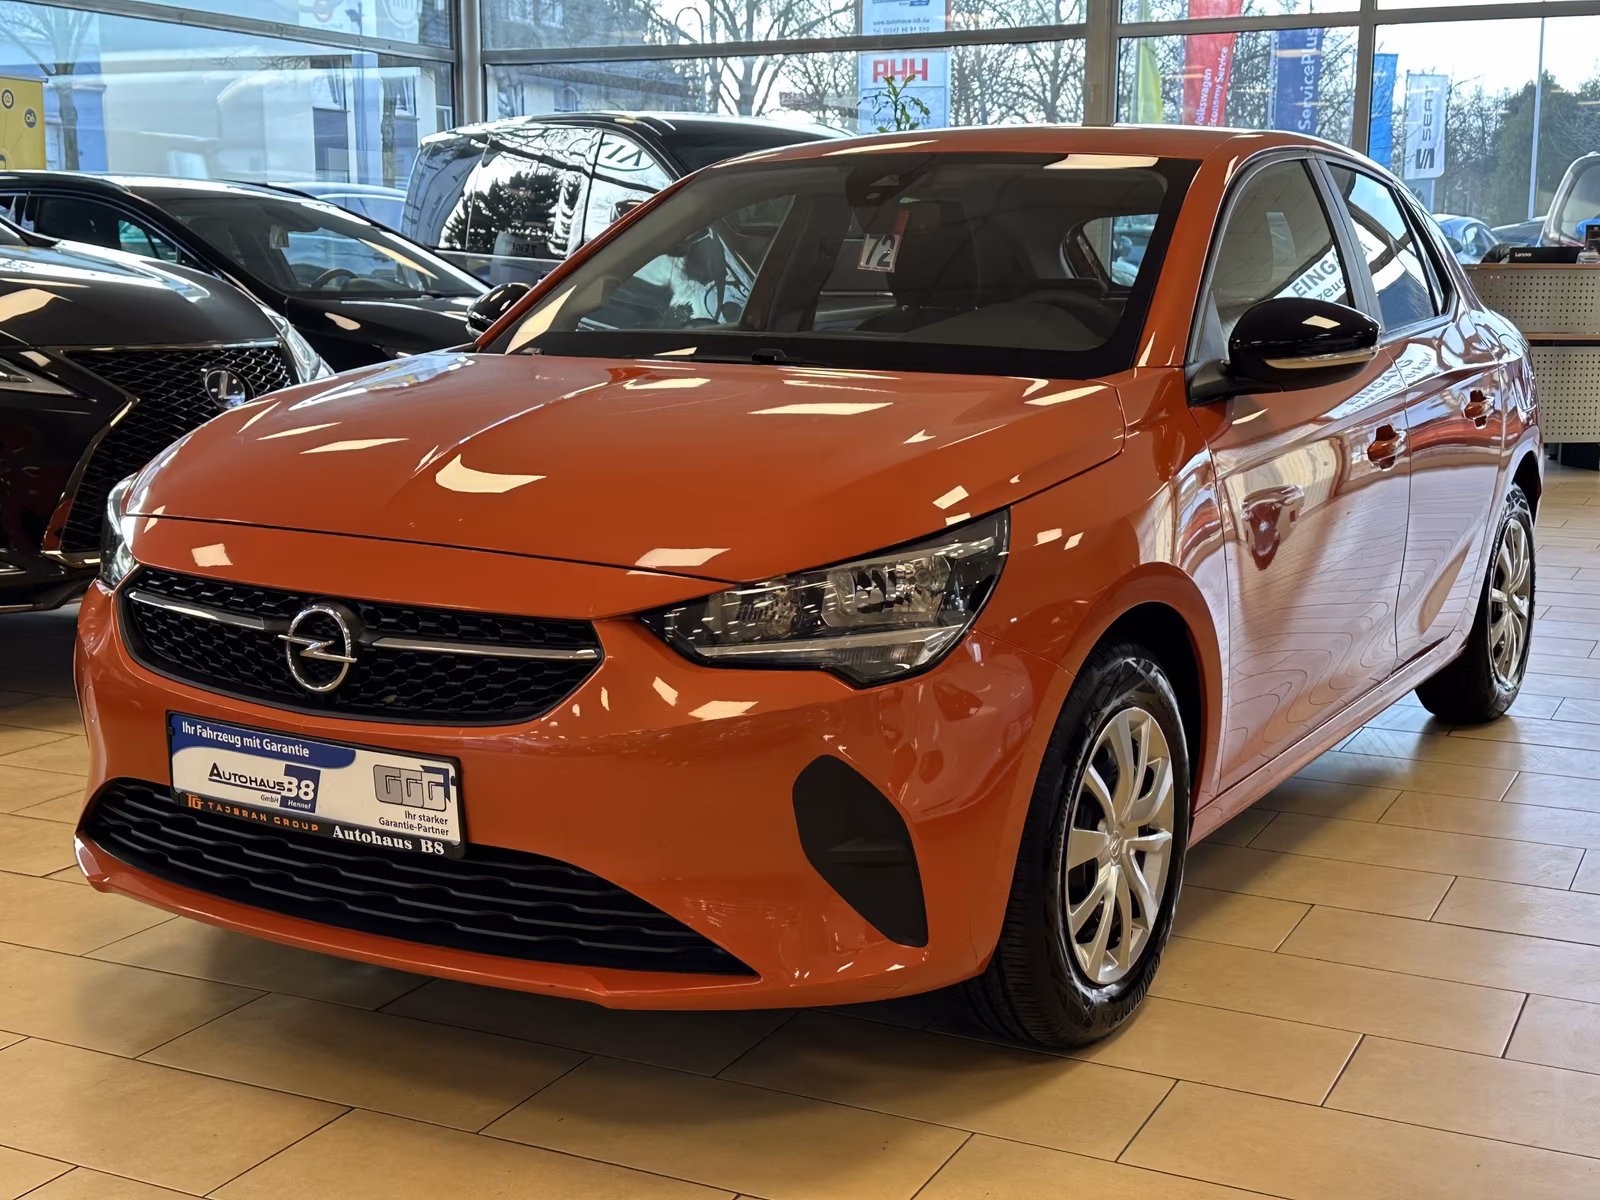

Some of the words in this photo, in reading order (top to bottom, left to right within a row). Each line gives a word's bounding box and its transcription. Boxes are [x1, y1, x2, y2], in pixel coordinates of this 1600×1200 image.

[1215, 47, 1228, 83] Service
[1298, 28, 1318, 130] ServicePlus
[1422, 85, 1434, 141] SEAT
[182, 721, 195, 735] Ihr
[196, 725, 241, 748] Fahrzeug
[243, 736, 261, 749] mit
[262, 738, 310, 758] Garantie
[260, 794, 279, 804] GmbH
[281, 775, 315, 801] B8
[273, 816, 319, 832] GROUP
[378, 816, 450, 837] Garantie-Partner
[404, 810, 417, 821] Ihr
[418, 813, 449, 826] starker
[332, 825, 413, 851] Autohaus
[419, 838, 445, 856] B8
